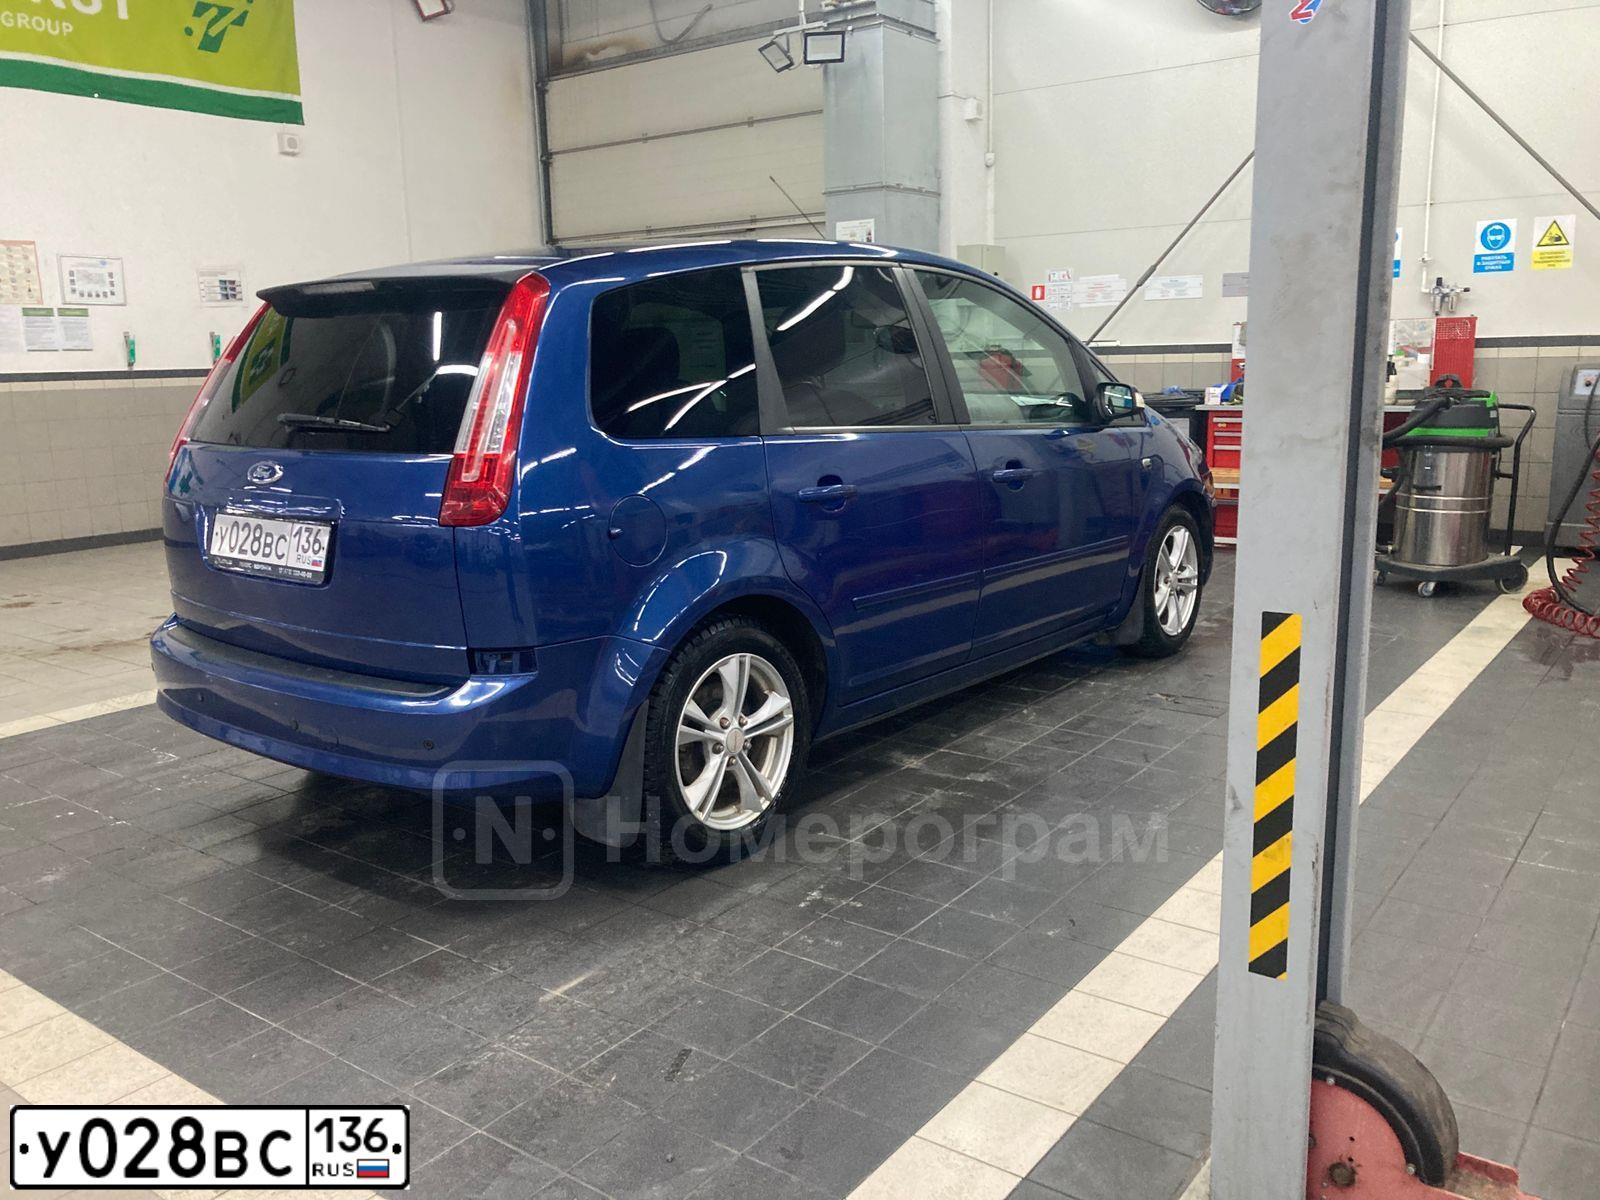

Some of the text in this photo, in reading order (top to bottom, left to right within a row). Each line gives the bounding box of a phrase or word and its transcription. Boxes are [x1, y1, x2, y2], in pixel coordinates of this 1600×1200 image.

[0, 10, 74, 36] GROUP
[219, 520, 322, 560] У028ВС 136
[296, 554, 311, 565] RUS
